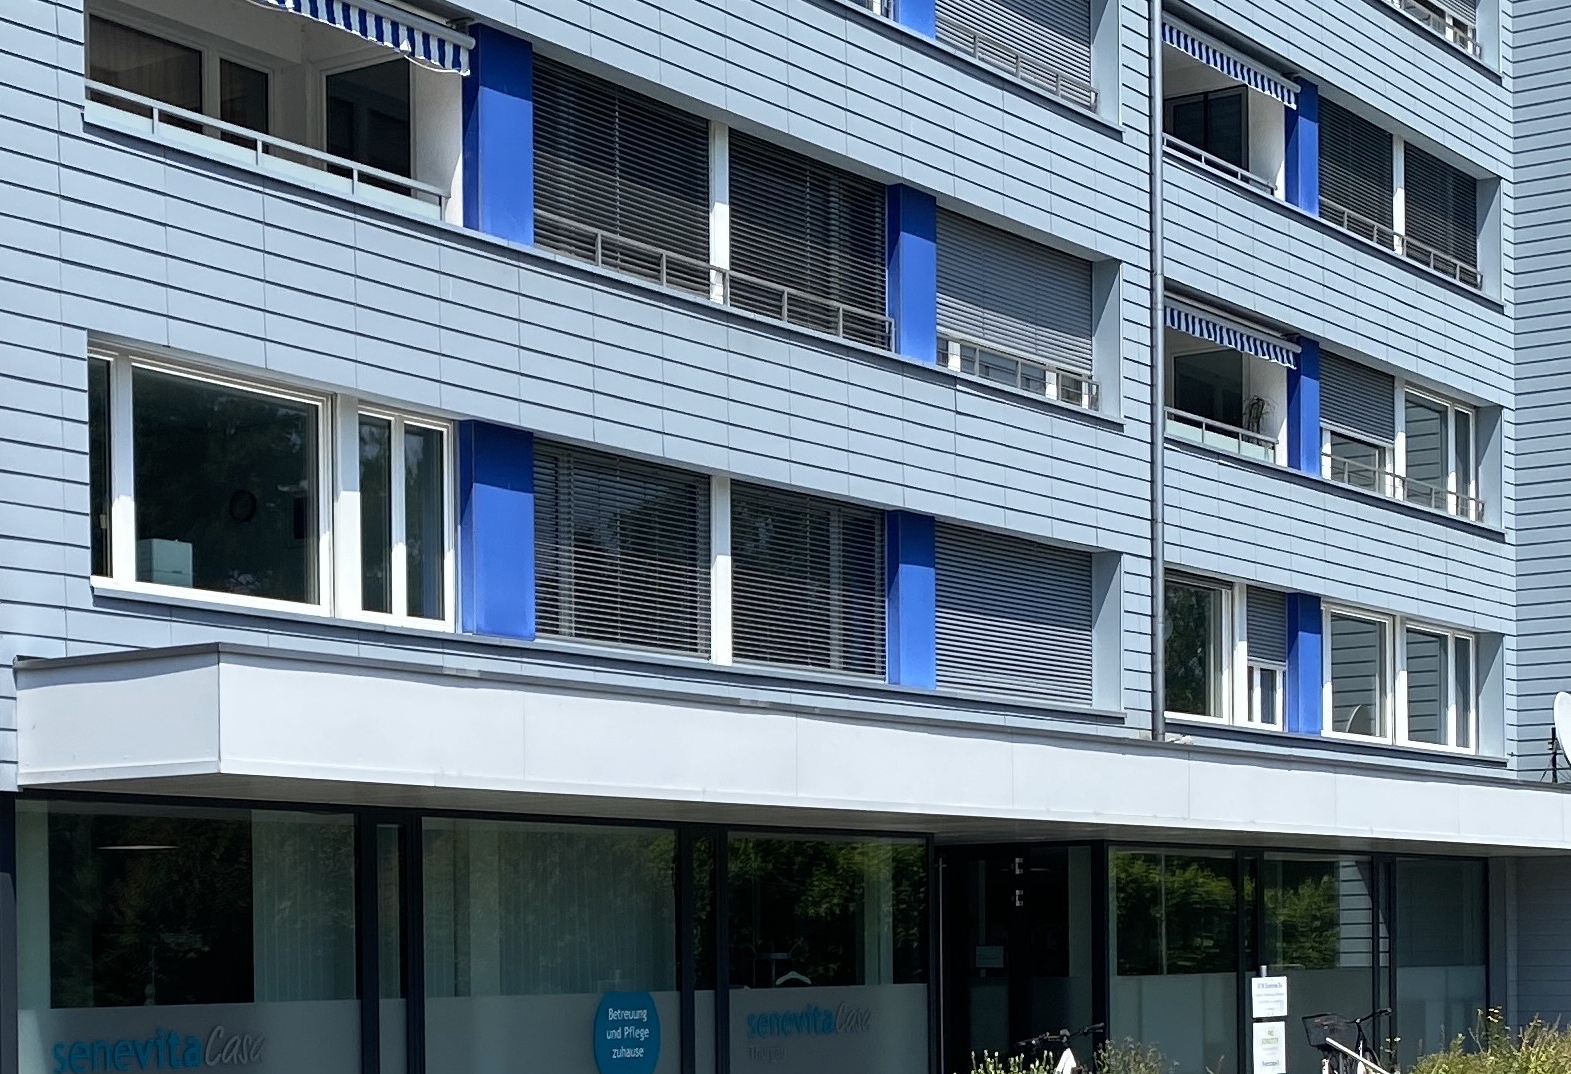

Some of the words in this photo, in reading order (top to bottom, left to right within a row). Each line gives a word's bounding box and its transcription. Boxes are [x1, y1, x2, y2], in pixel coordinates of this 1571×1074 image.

[608, 1007, 648, 1022] Betreuung
[606, 1026, 622, 1040] und
[623, 1026, 650, 1041] Pflege
[612, 1045, 645, 1059] zuhause
